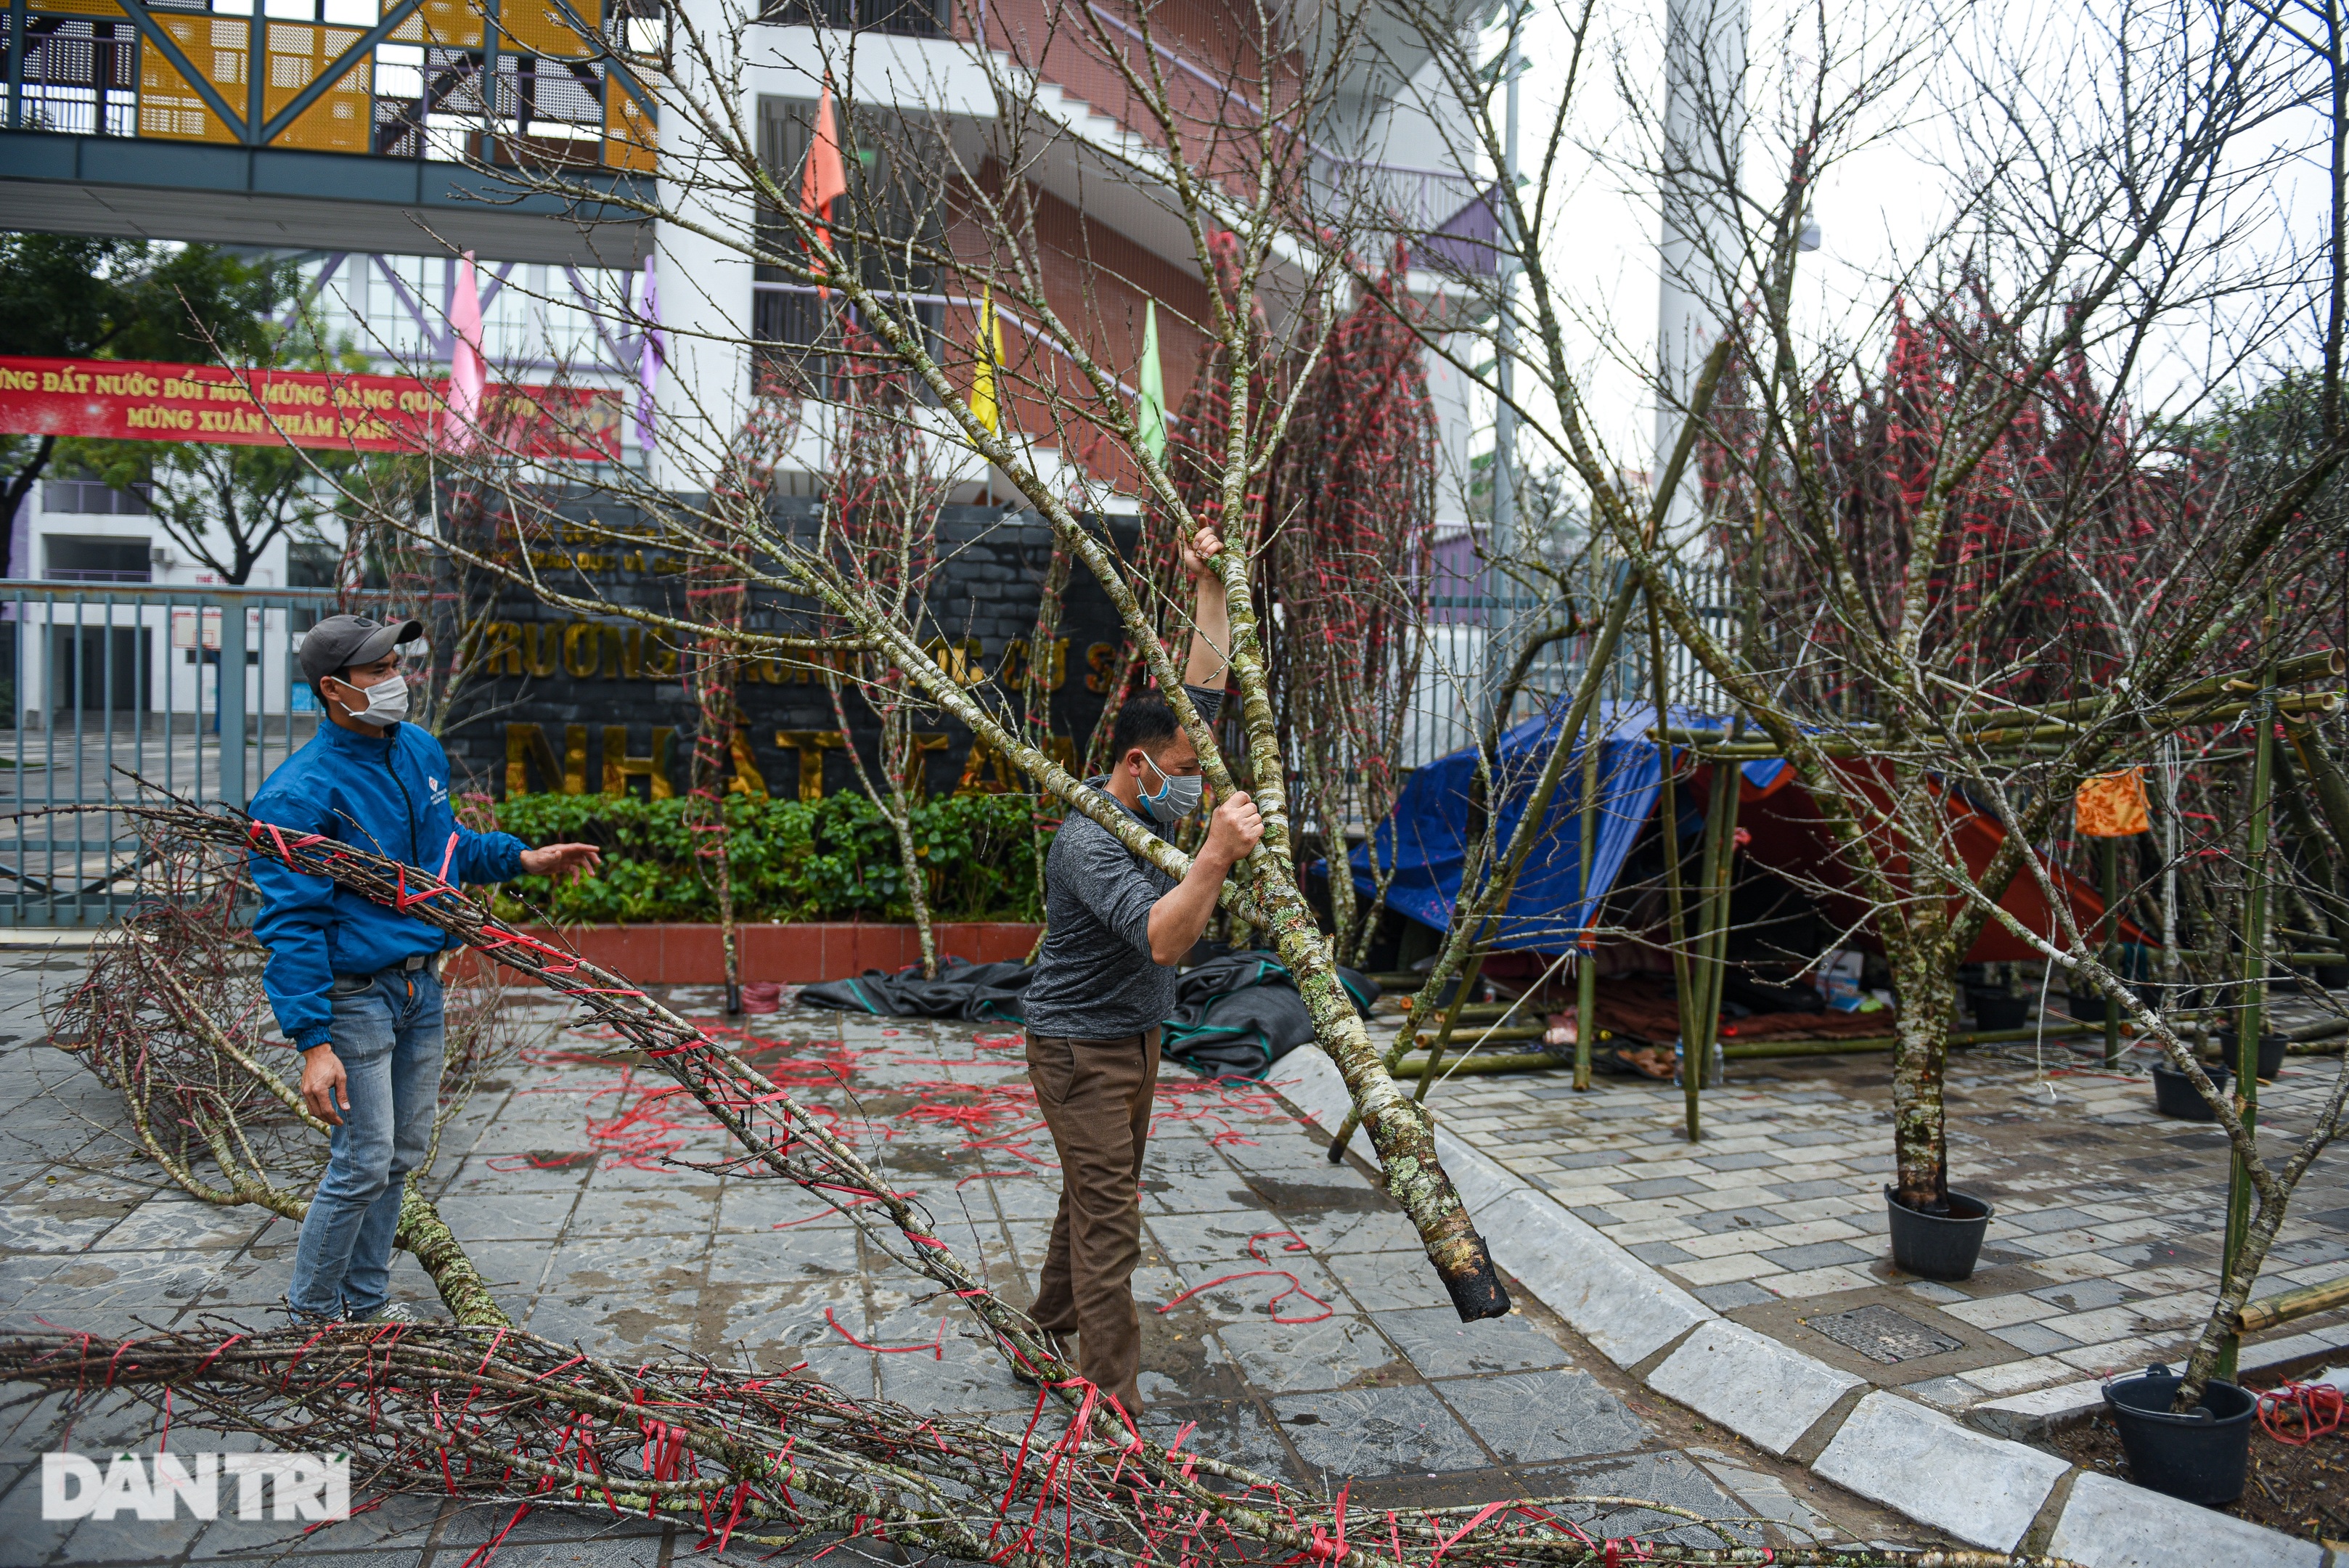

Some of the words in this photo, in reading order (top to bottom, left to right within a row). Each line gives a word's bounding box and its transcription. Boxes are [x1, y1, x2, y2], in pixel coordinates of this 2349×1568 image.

[42, 365, 91, 394] ĐẤT
[126, 403, 194, 430] MỪNG
[198, 407, 264, 433] XUÂN
[269, 409, 335, 438] NHÂM
[1085, 642, 1119, 693] S
